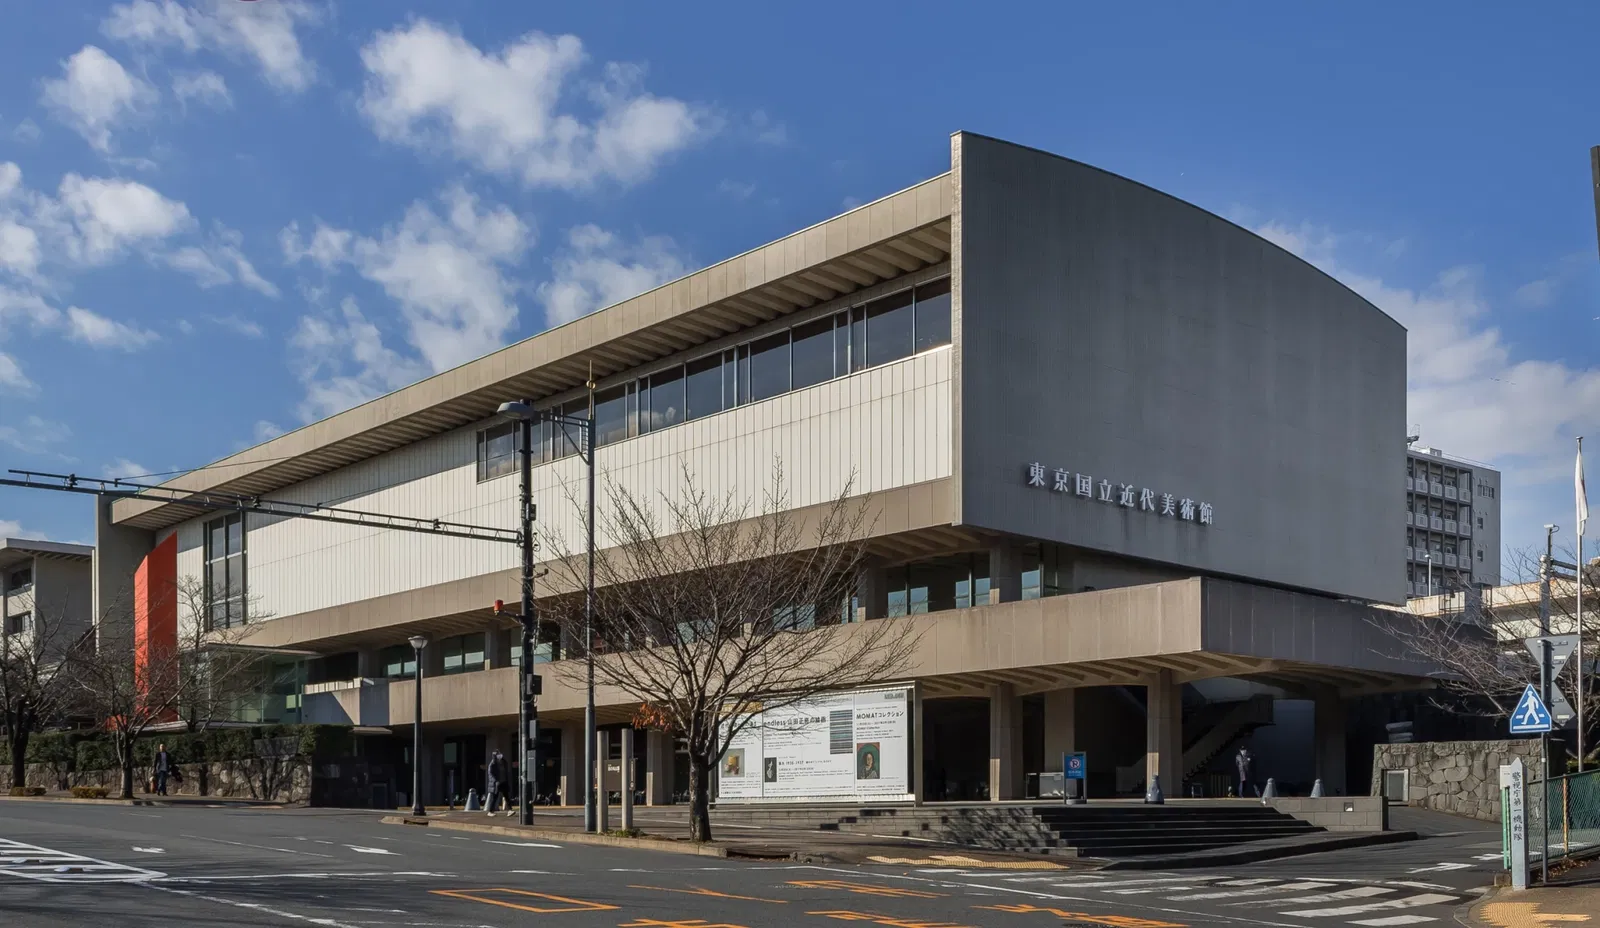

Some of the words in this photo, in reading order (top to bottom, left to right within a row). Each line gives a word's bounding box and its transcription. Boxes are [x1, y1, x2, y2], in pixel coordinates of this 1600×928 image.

[1028, 462, 1213, 525] 東京国立近代美術館
[1512, 771, 1523, 841] 警視庁第一機動隊
